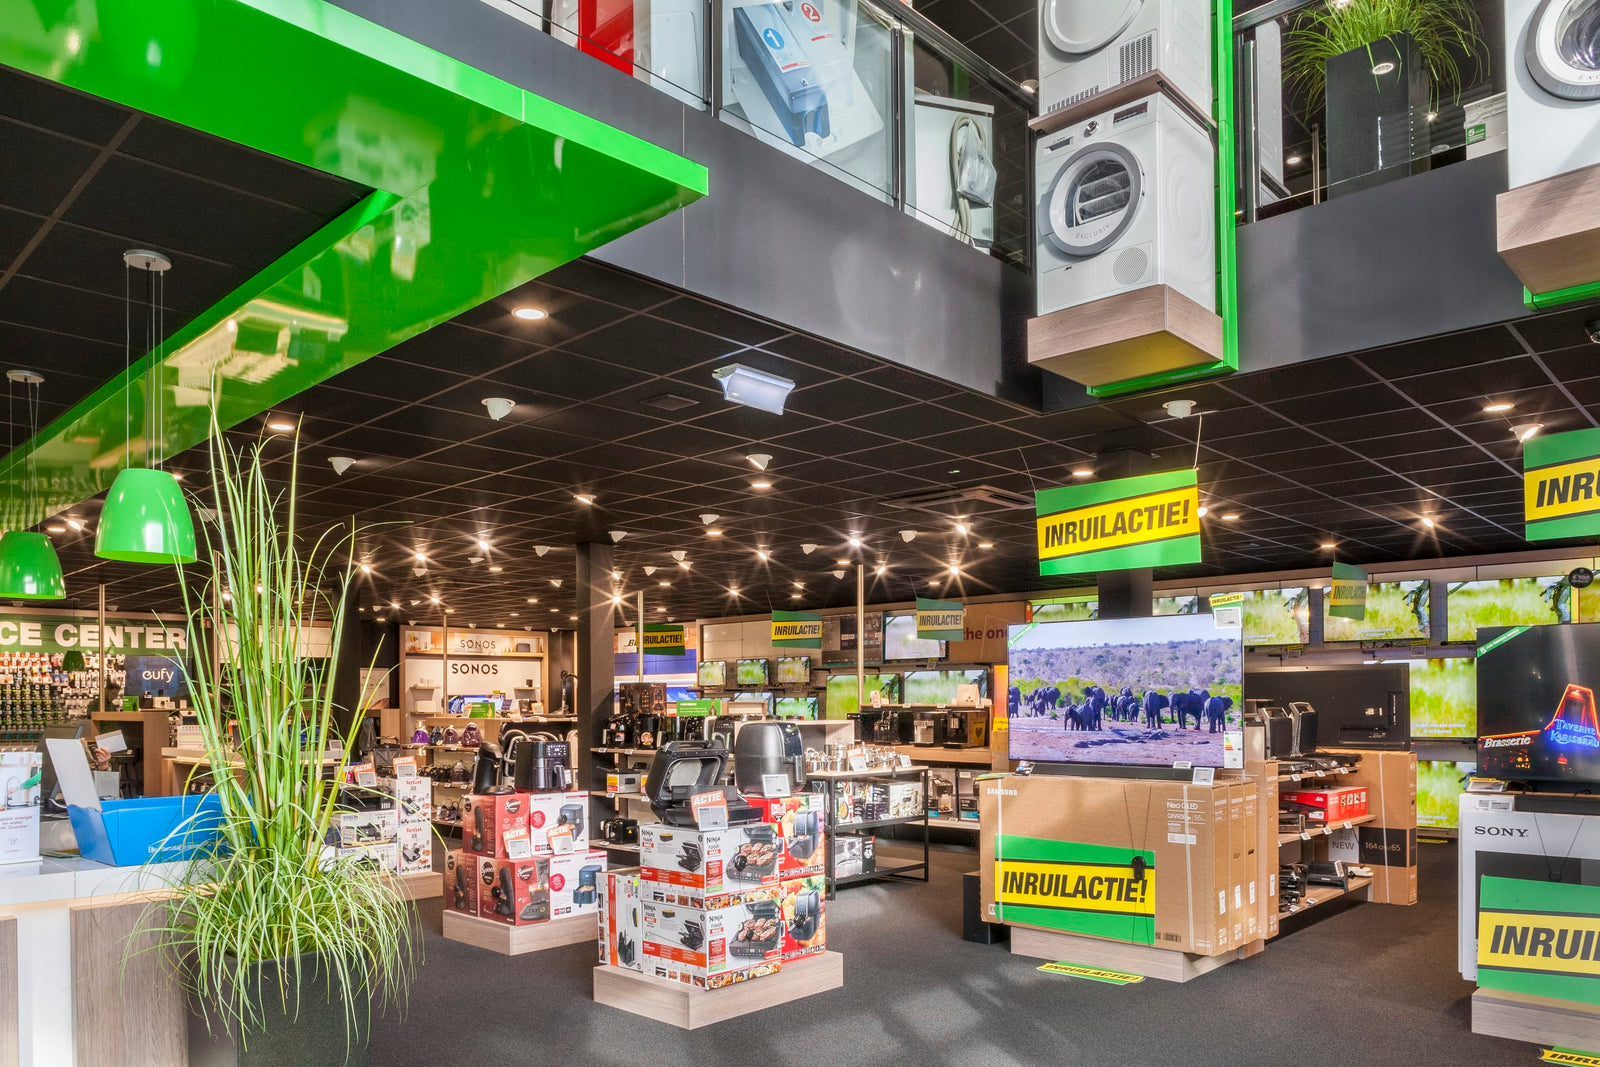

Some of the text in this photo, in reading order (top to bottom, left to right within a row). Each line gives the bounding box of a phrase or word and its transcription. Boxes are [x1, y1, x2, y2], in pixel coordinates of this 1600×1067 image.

[804, 4, 819, 20] 2
[766, 30, 780, 47] 1
[1075, 223, 1110, 240] EXCLUSIV
[1536, 470, 1600, 508] INR
[1044, 499, 1190, 549] INRUILACTIE!
[1212, 594, 1242, 605] INRUILACTIE!
[919, 614, 962, 626] INRUILACTIE!
[54, 623, 187, 650] CENTER
[774, 624, 820, 635] INRUILACTIE!
[963, 627, 983, 640] he
[460, 639, 496, 649] SONOS
[643, 634, 682, 644] RUILACTIE!
[142, 668, 174, 683] eufy
[451, 663, 498, 675] SONOS
[1554, 718, 1596, 736] TAVERNE
[1483, 735, 1531, 749] Brasserie
[986, 787, 1018, 796] SAMSUNG
[693, 792, 723, 806] ACTIE
[505, 828, 527, 839] ACTIE
[1474, 825, 1529, 837] SONY
[1332, 841, 1355, 850] NEW
[1002, 870, 1148, 904] INRUILACTIE!
[1045, 962, 1140, 982] INRUILACTIE!
